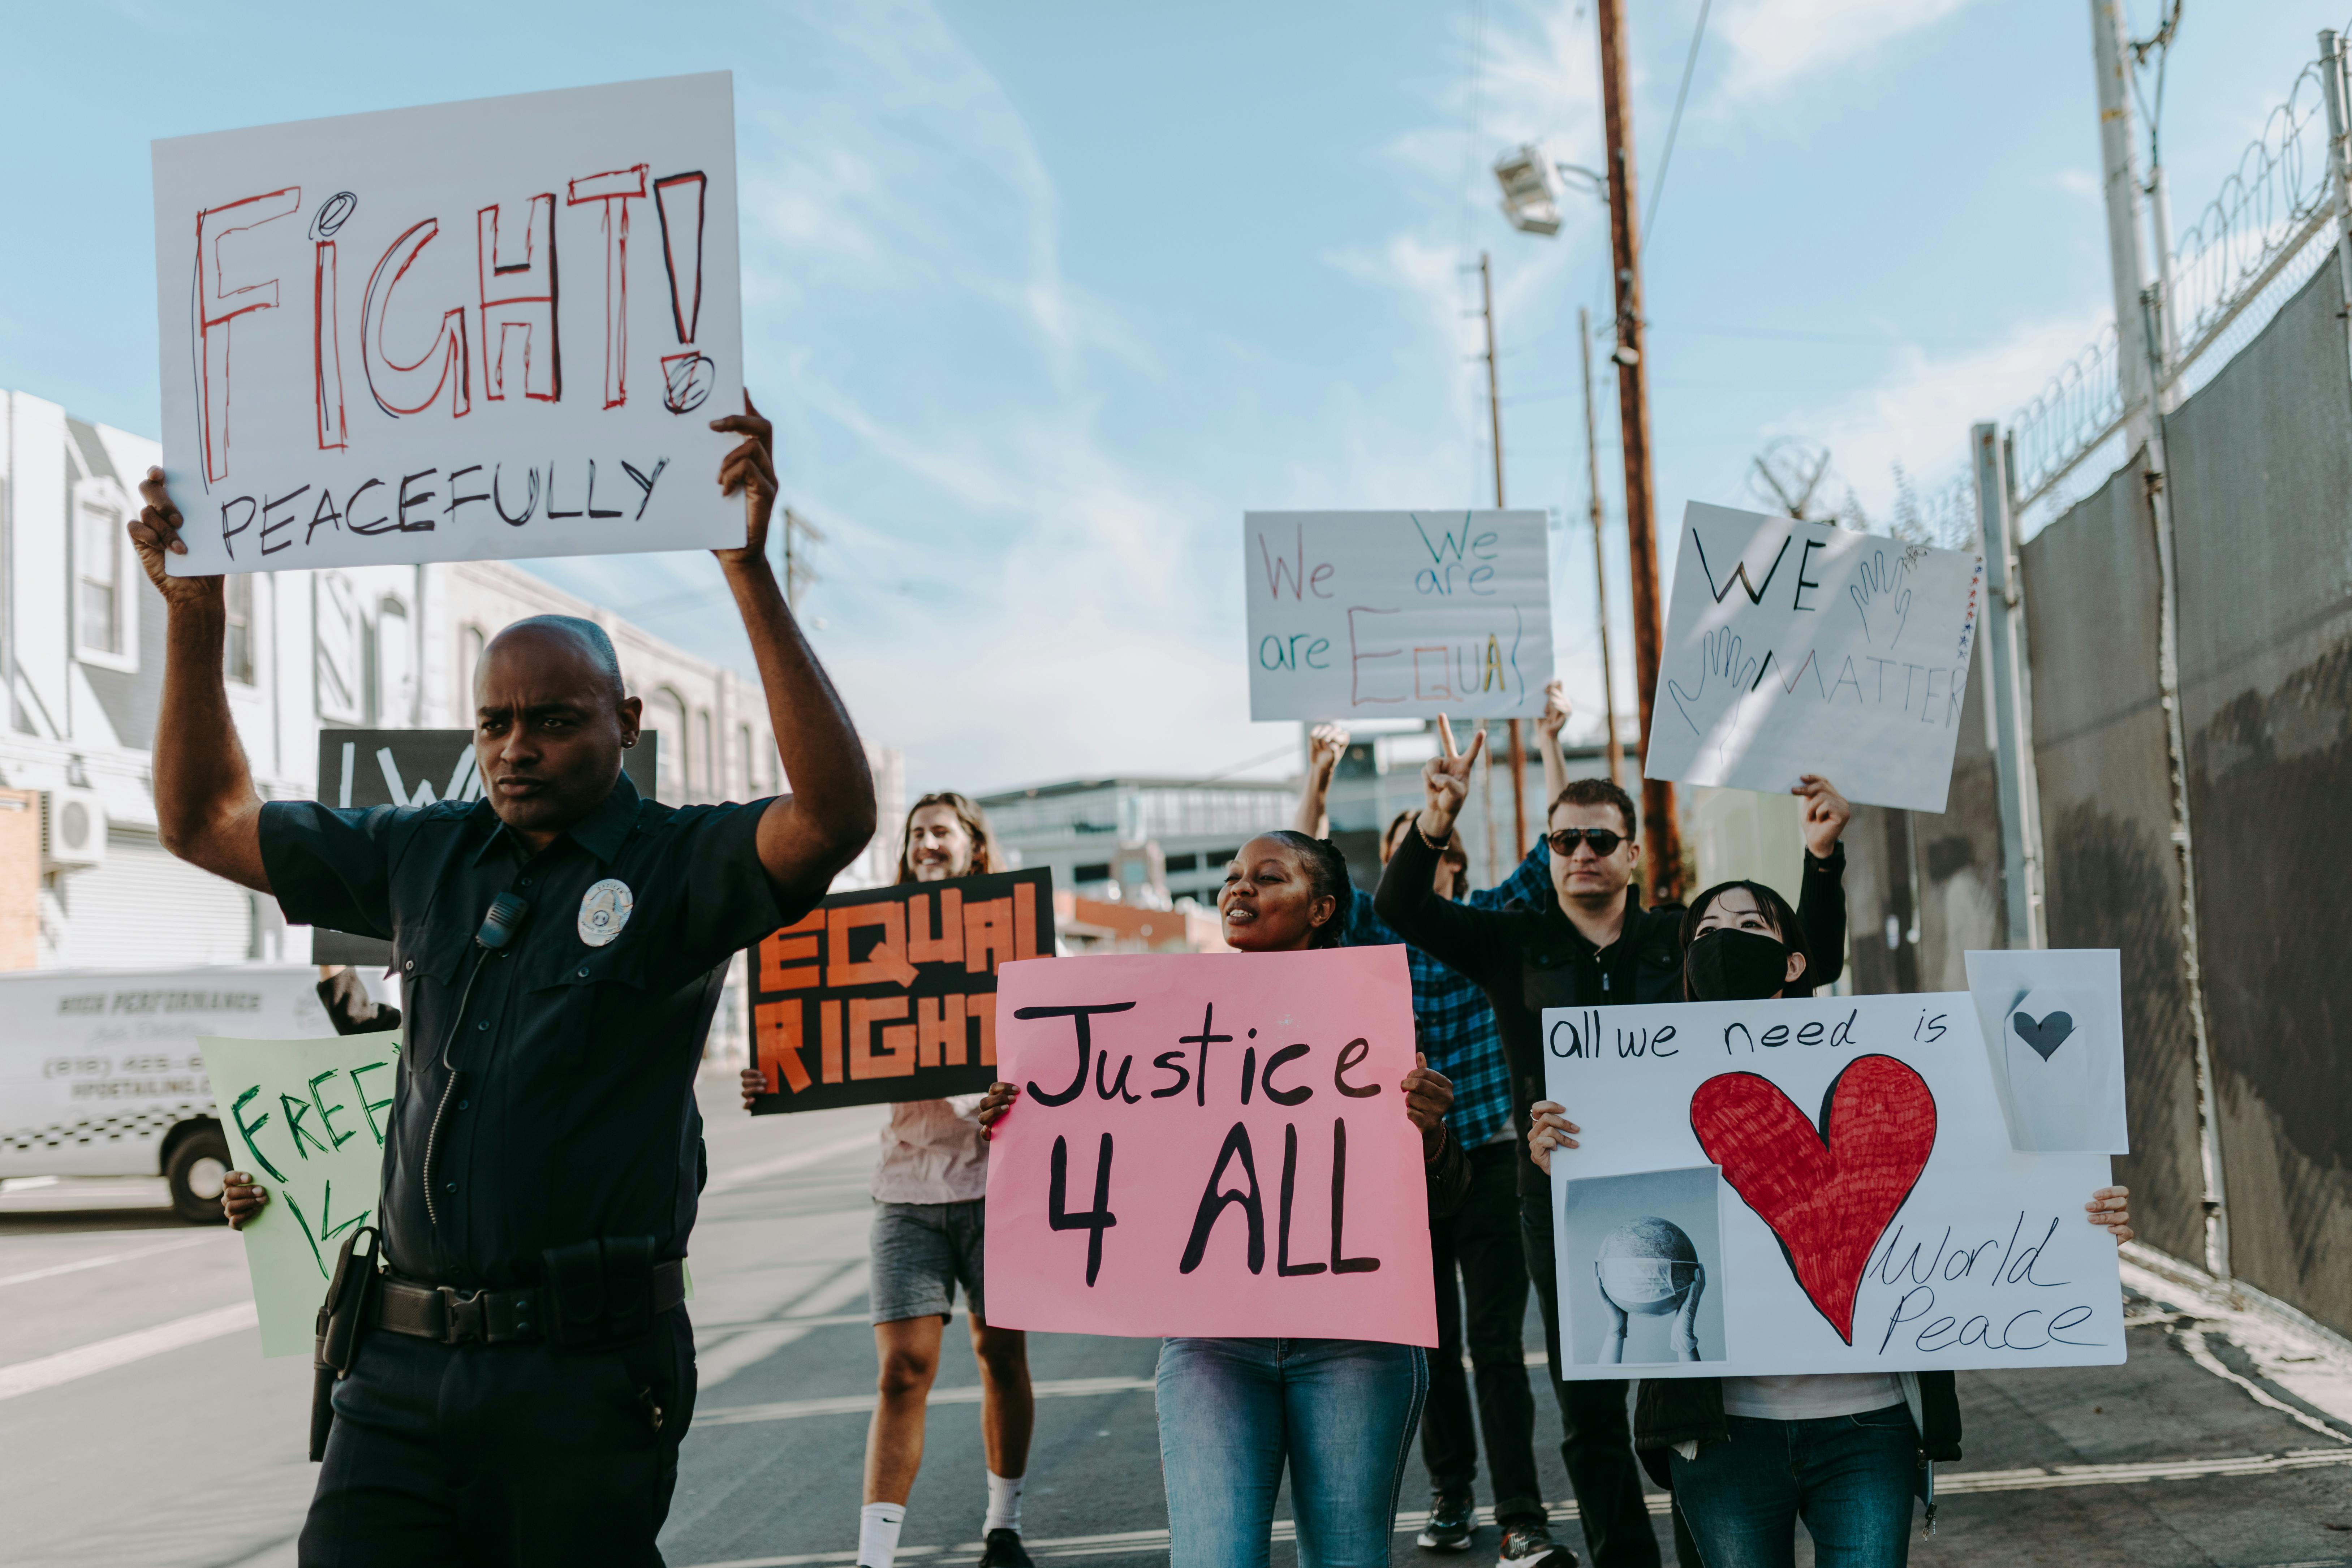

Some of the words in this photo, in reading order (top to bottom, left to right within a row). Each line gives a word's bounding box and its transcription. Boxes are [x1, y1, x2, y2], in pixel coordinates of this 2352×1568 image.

[221, 456, 669, 560] PEACEFULLY
[1411, 510, 1498, 563] We
[1259, 523, 1334, 601] We
[1416, 563, 1496, 596] are
[1693, 528, 1826, 611] WE
[1260, 633, 1330, 671] are
[1752, 649, 1968, 729] MATTER
[759, 882, 1052, 993] EQUAL
[755, 992, 997, 1094] RIGHT
[1013, 1001, 1381, 1107] Justice
[1550, 1009, 1600, 1060] all
[1617, 1021, 1679, 1056] we
[1724, 1009, 1857, 1054] need
[1914, 1008, 1948, 1043] is
[231, 1042, 402, 1183] FREE
[1049, 1132, 1117, 1288] 4
[1179, 1117, 1380, 1277] ALL
[1869, 1210, 2071, 1286] World
[1879, 1286, 2109, 1355] Peace
